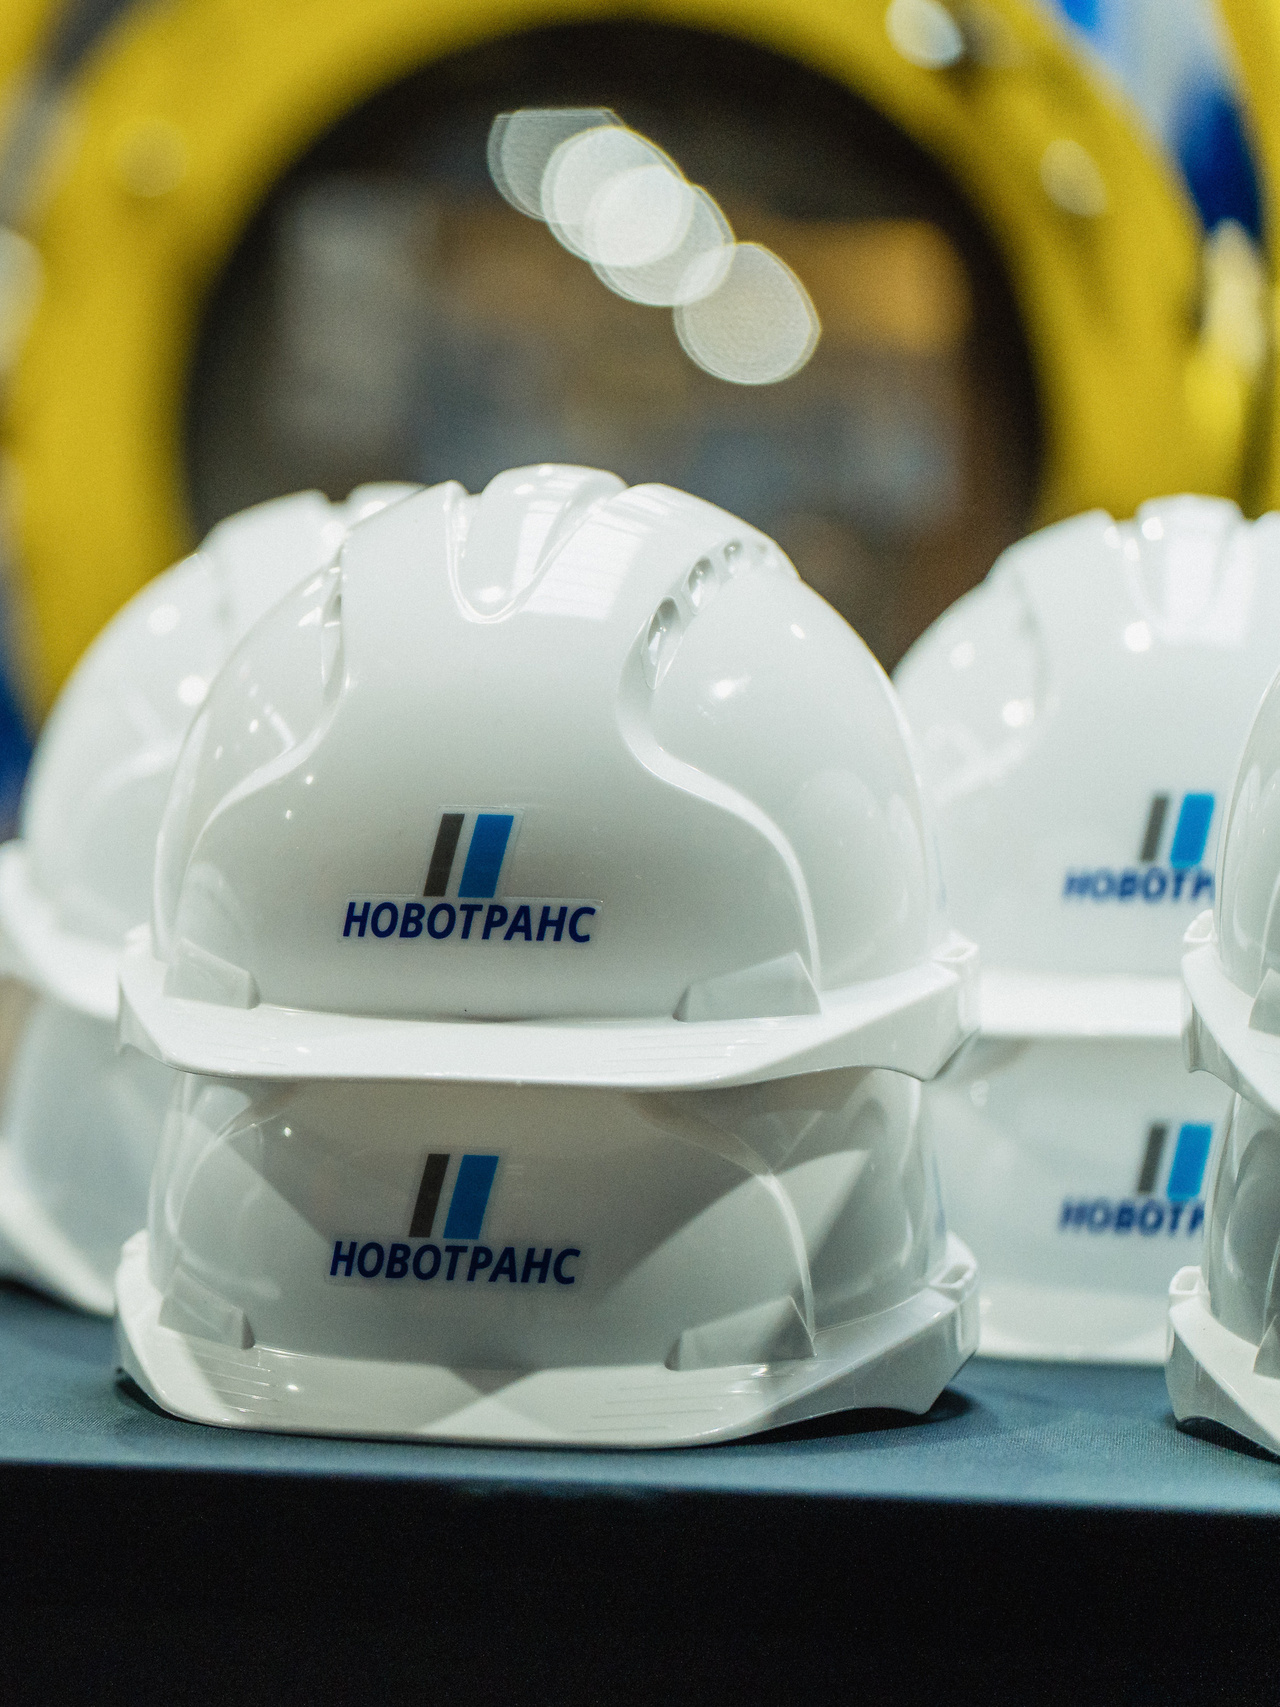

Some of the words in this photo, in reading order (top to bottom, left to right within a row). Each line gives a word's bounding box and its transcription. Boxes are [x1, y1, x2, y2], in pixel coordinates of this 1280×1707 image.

[1064, 868, 1215, 902] НОВОТР
[343, 902, 596, 942] НОВОТРАНС
[330, 1241, 581, 1284] НОВОТРАНС
